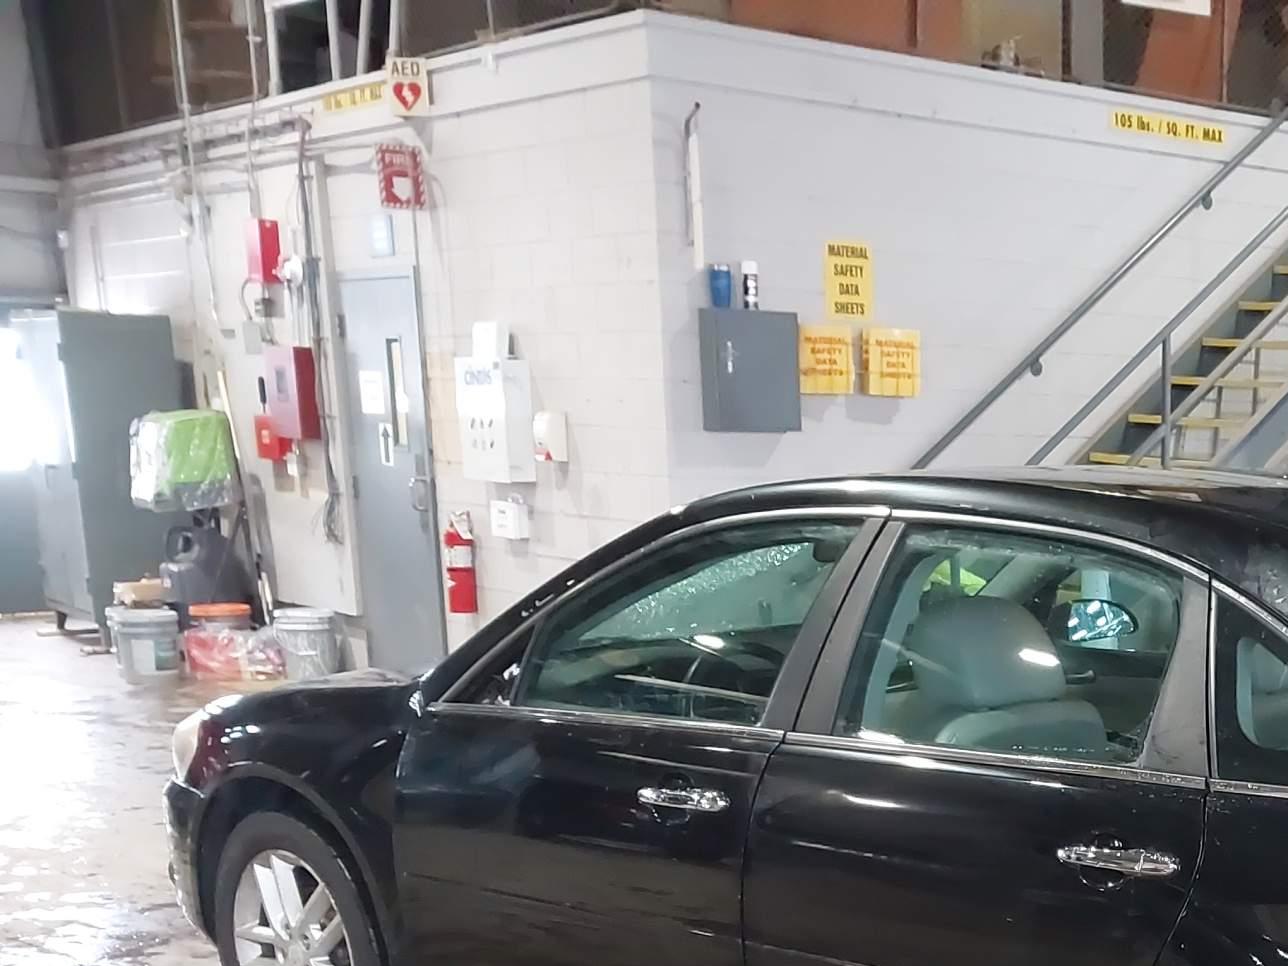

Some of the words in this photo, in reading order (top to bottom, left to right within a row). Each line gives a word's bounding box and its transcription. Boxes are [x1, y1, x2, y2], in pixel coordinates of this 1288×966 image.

[391, 60, 421, 77] AED
[1114, 112, 1133, 128] 105
[1136, 115, 1154, 133] lbs.
[1166, 121, 1181, 137] SQ.
[1185, 124, 1199, 140] FT.
[1202, 128, 1223, 143] MAX
[828, 244, 868, 260] MATERIAL
[833, 263, 864, 278] SAFETY
[838, 282, 860, 297] DATA
[834, 301, 865, 316] SHEETS
